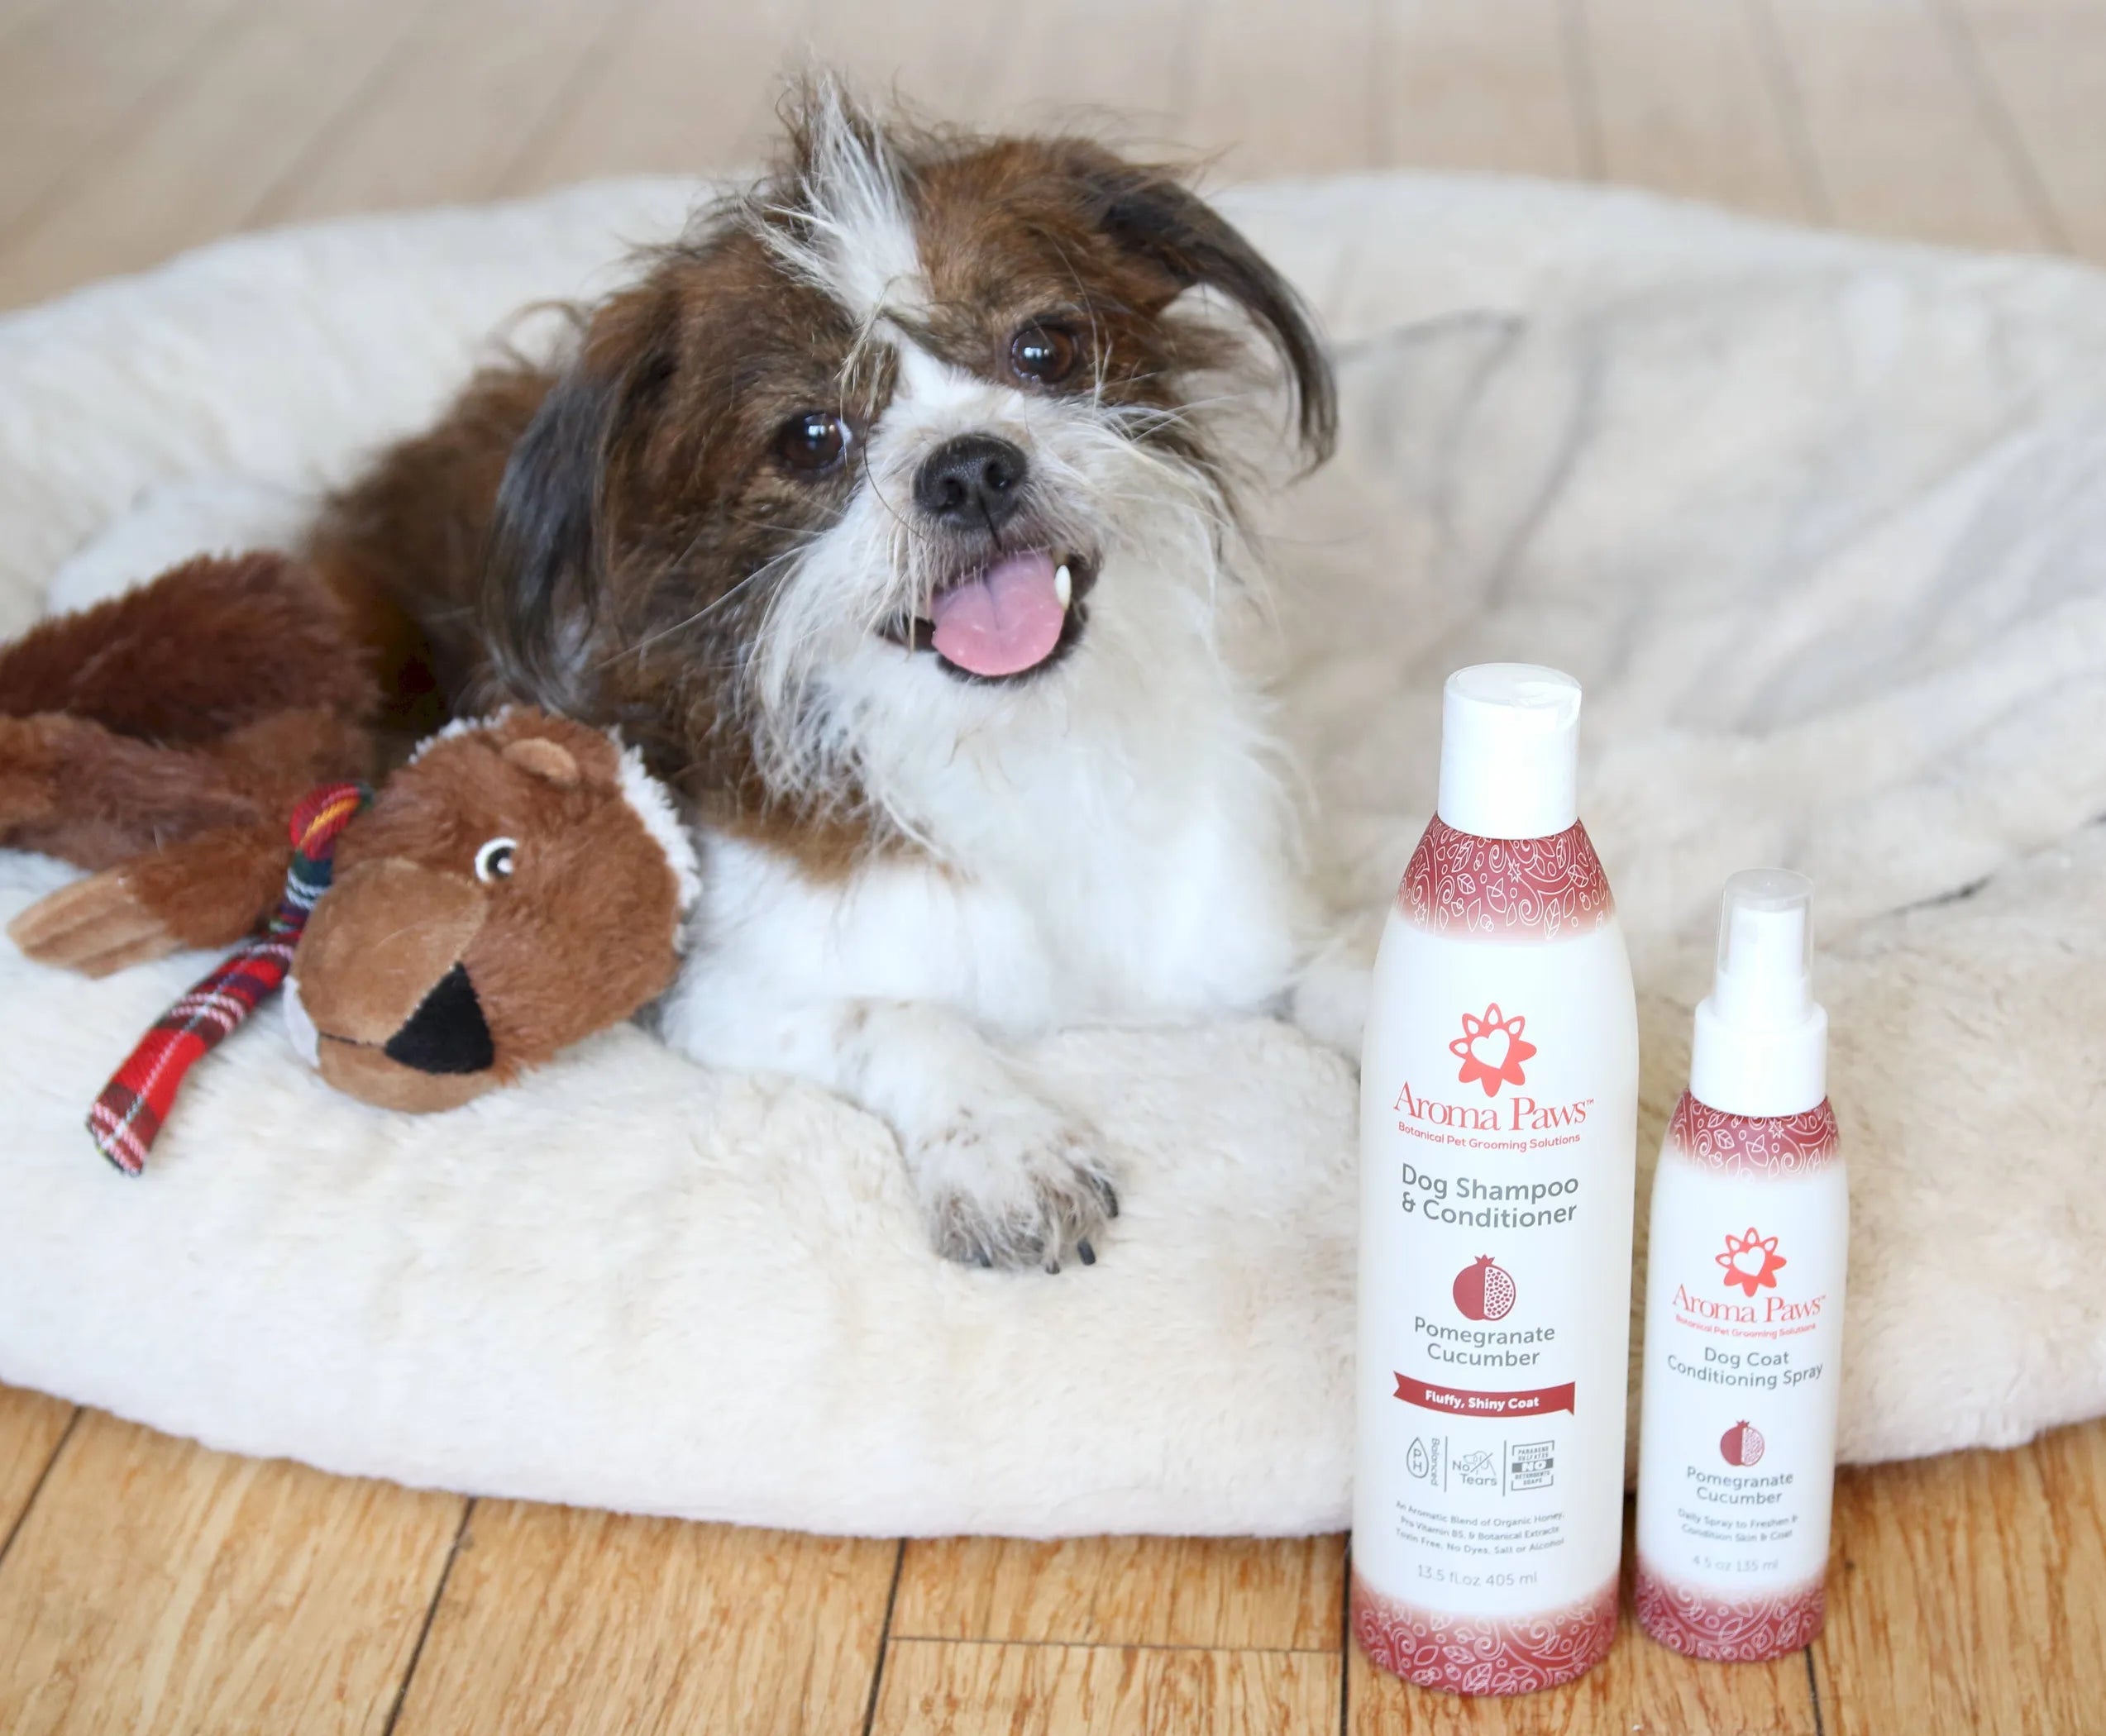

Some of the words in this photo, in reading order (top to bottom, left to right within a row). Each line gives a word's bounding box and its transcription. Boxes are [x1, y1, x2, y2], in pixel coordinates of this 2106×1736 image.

[1393, 1080, 1501, 1131] Aroma
[1398, 1121, 1445, 1143] Botanical
[1447, 1135, 1467, 1147] Pet
[1468, 1138, 1527, 1152] Grooming
[1530, 1133, 1580, 1148] Solutions
[1402, 1162, 1448, 1199] Dog
[1456, 1176, 1579, 1204] Shampoo
[1402, 1191, 1416, 1213] &
[1423, 1199, 1577, 1228] Conditioner
[1672, 1284, 1757, 1323] Aroma
[1415, 1316, 1555, 1347] Pomegranate
[1675, 1314, 1712, 1332] Botanical
[1714, 1326, 1730, 1336] Pet
[1731, 1328, 1778, 1339] Grooming
[1779, 1323, 1816, 1336] Solutions
[1427, 1343, 1540, 1366] Cucumber
[1704, 1347, 1741, 1368] Dog
[1747, 1352, 1789, 1366] Coat
[1667, 1355, 1778, 1390] Conditioning
[1783, 1362, 1824, 1386] Spray
[1425, 1390, 1465, 1409] Fluffy,
[1468, 1396, 1506, 1412] Shiny
[1507, 1396, 1540, 1409] Coat
[1452, 1461, 1470, 1472] No
[1687, 1466, 1793, 1490] Pomegranate
[1461, 1474, 1497, 1487] Tears
[1697, 1487, 1783, 1505] Cucumber
[1408, 1505, 1448, 1523] Aromatic
[1450, 1516, 1478, 1526] Blend
[1480, 1518, 1492, 1526] of
[1493, 1518, 1532, 1528] Organic
[1703, 1515, 1733, 1529] Spray
[1736, 1520, 1747, 1529] to
[1416, 1521, 1449, 1536] Vitamin
[1478, 1532, 1522, 1541] Botanical
[1735, 1533, 1757, 1543] Skin
[1769, 1529, 1793, 1541] Coat
[1447, 1543, 1461, 1552] No
[1494, 1546, 1513, 1555] Salt
[1529, 1538, 1564, 1552] Alcohol
[1417, 1563, 1445, 1582] 13.5
[1486, 1574, 1516, 1586] 405
[1519, 1571, 1539, 1585] ml
[1736, 1561, 1760, 1573] 135
